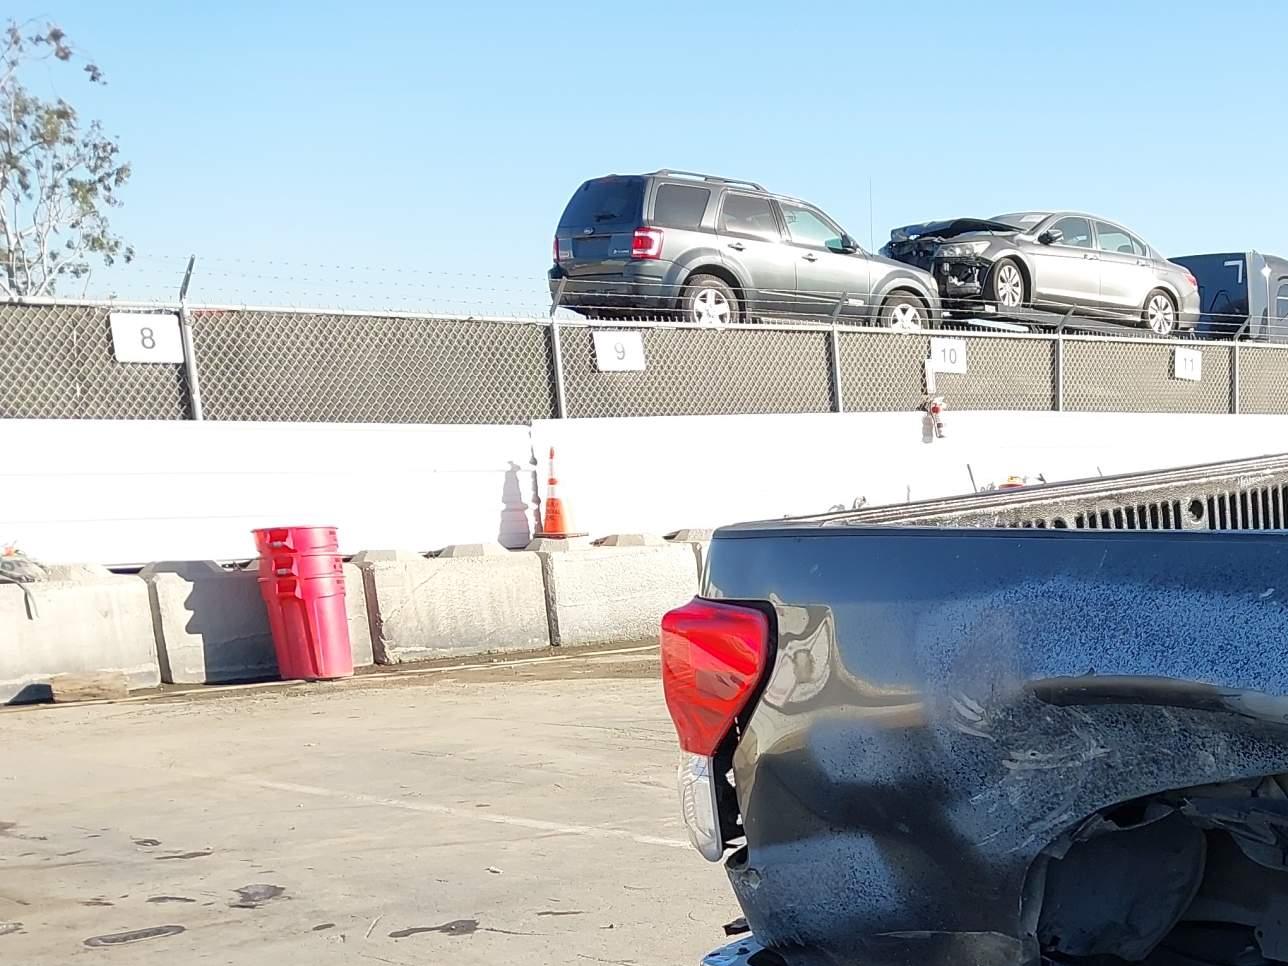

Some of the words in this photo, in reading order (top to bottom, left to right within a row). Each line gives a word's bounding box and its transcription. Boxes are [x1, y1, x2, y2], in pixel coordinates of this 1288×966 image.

[140, 327, 156, 349] 8
[614, 342, 625, 360] 9
[941, 348, 957, 365] 10
[1183, 358, 1194, 371] 11
